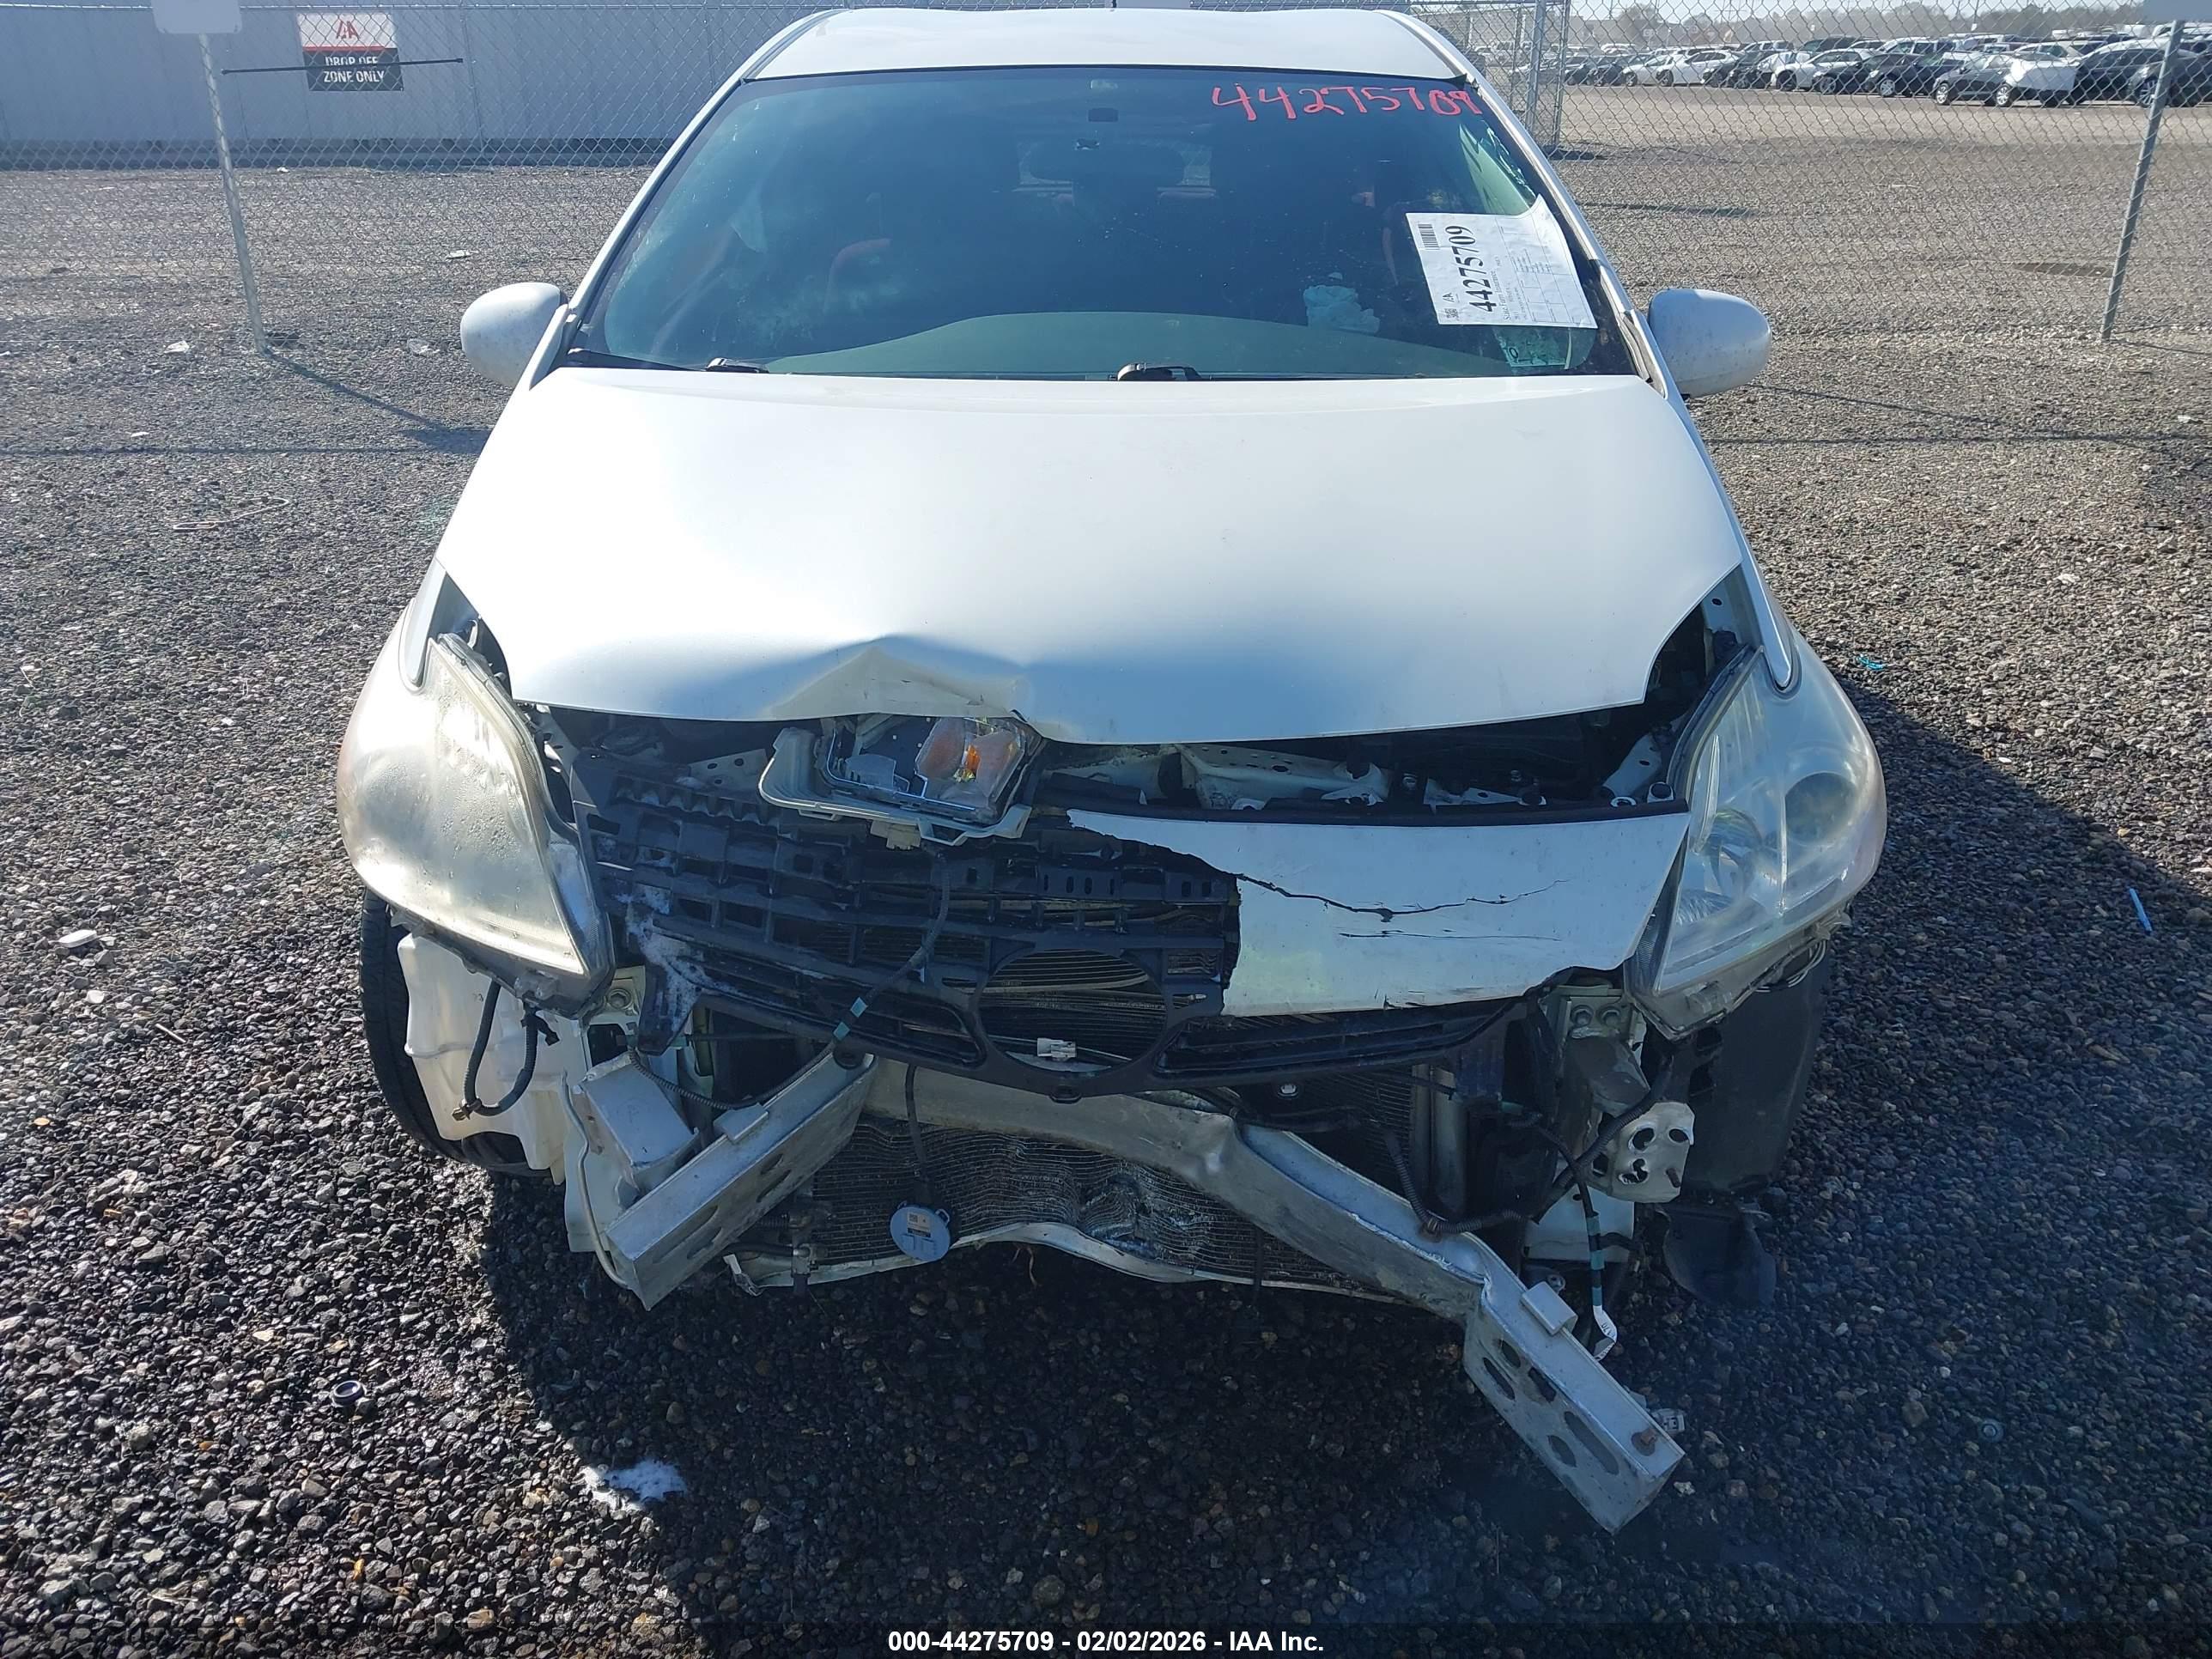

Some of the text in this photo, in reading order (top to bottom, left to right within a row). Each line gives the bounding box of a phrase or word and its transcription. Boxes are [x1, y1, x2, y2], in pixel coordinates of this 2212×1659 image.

[325, 56, 356, 67] DROP
[324, 70, 385, 82] ZONE ONLY
[1212, 84, 1483, 121] 44275709
[1445, 226, 1497, 312] 44275709
